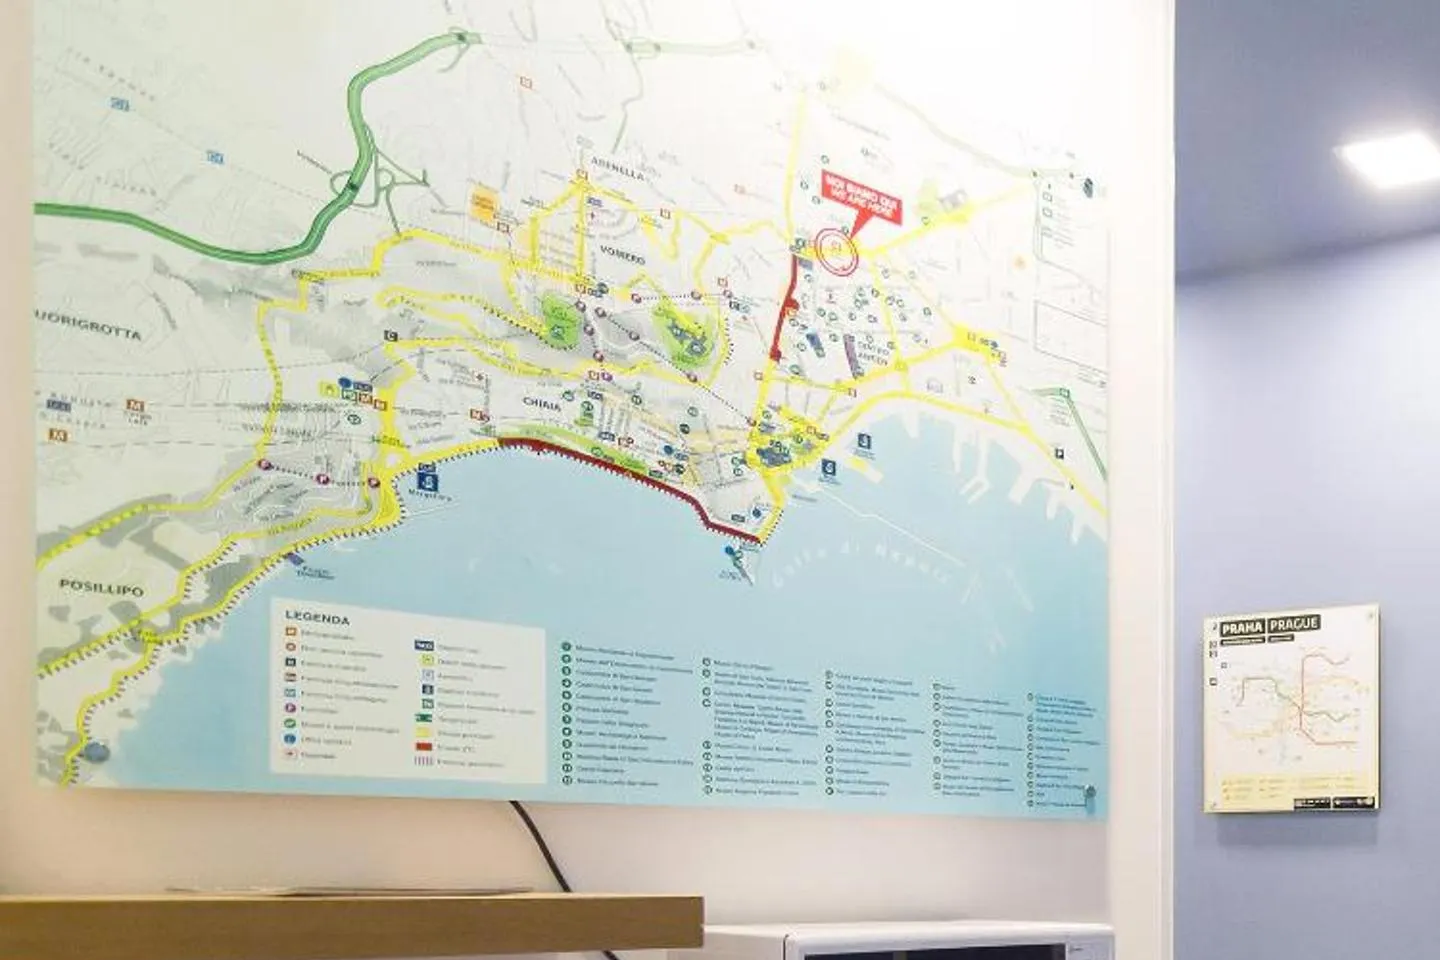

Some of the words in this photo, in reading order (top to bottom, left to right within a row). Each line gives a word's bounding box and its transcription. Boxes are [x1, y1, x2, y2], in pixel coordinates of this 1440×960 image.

[58, 577, 145, 599] POSILLIPO
[285, 609, 351, 626] LEGENDA
[1222, 621, 1264, 636] PRAHA
[1270, 616, 1319, 632] PRAGUE
